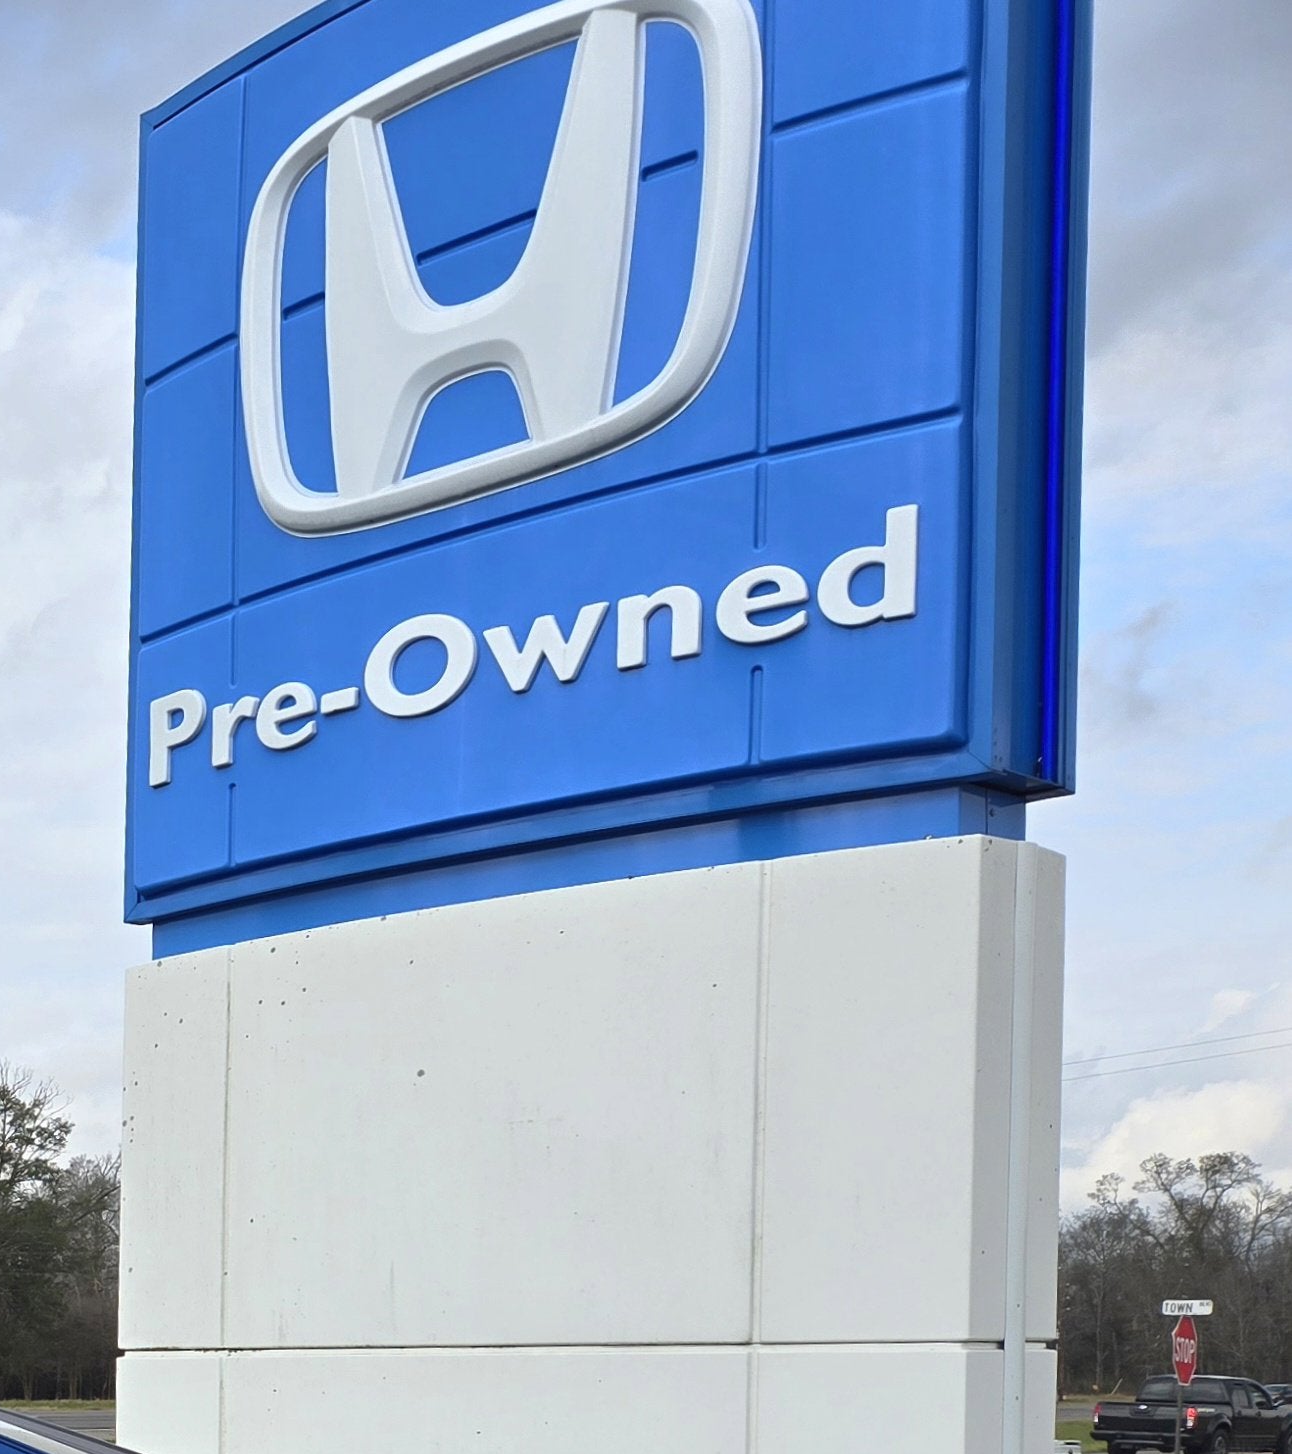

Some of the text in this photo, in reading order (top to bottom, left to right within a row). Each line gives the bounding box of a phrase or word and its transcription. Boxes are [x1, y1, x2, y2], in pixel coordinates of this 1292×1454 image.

[149, 503, 919, 788] Pre-Owned
[1165, 1302, 1194, 1313] TOWN
[1175, 1336, 1195, 1363] STOP
